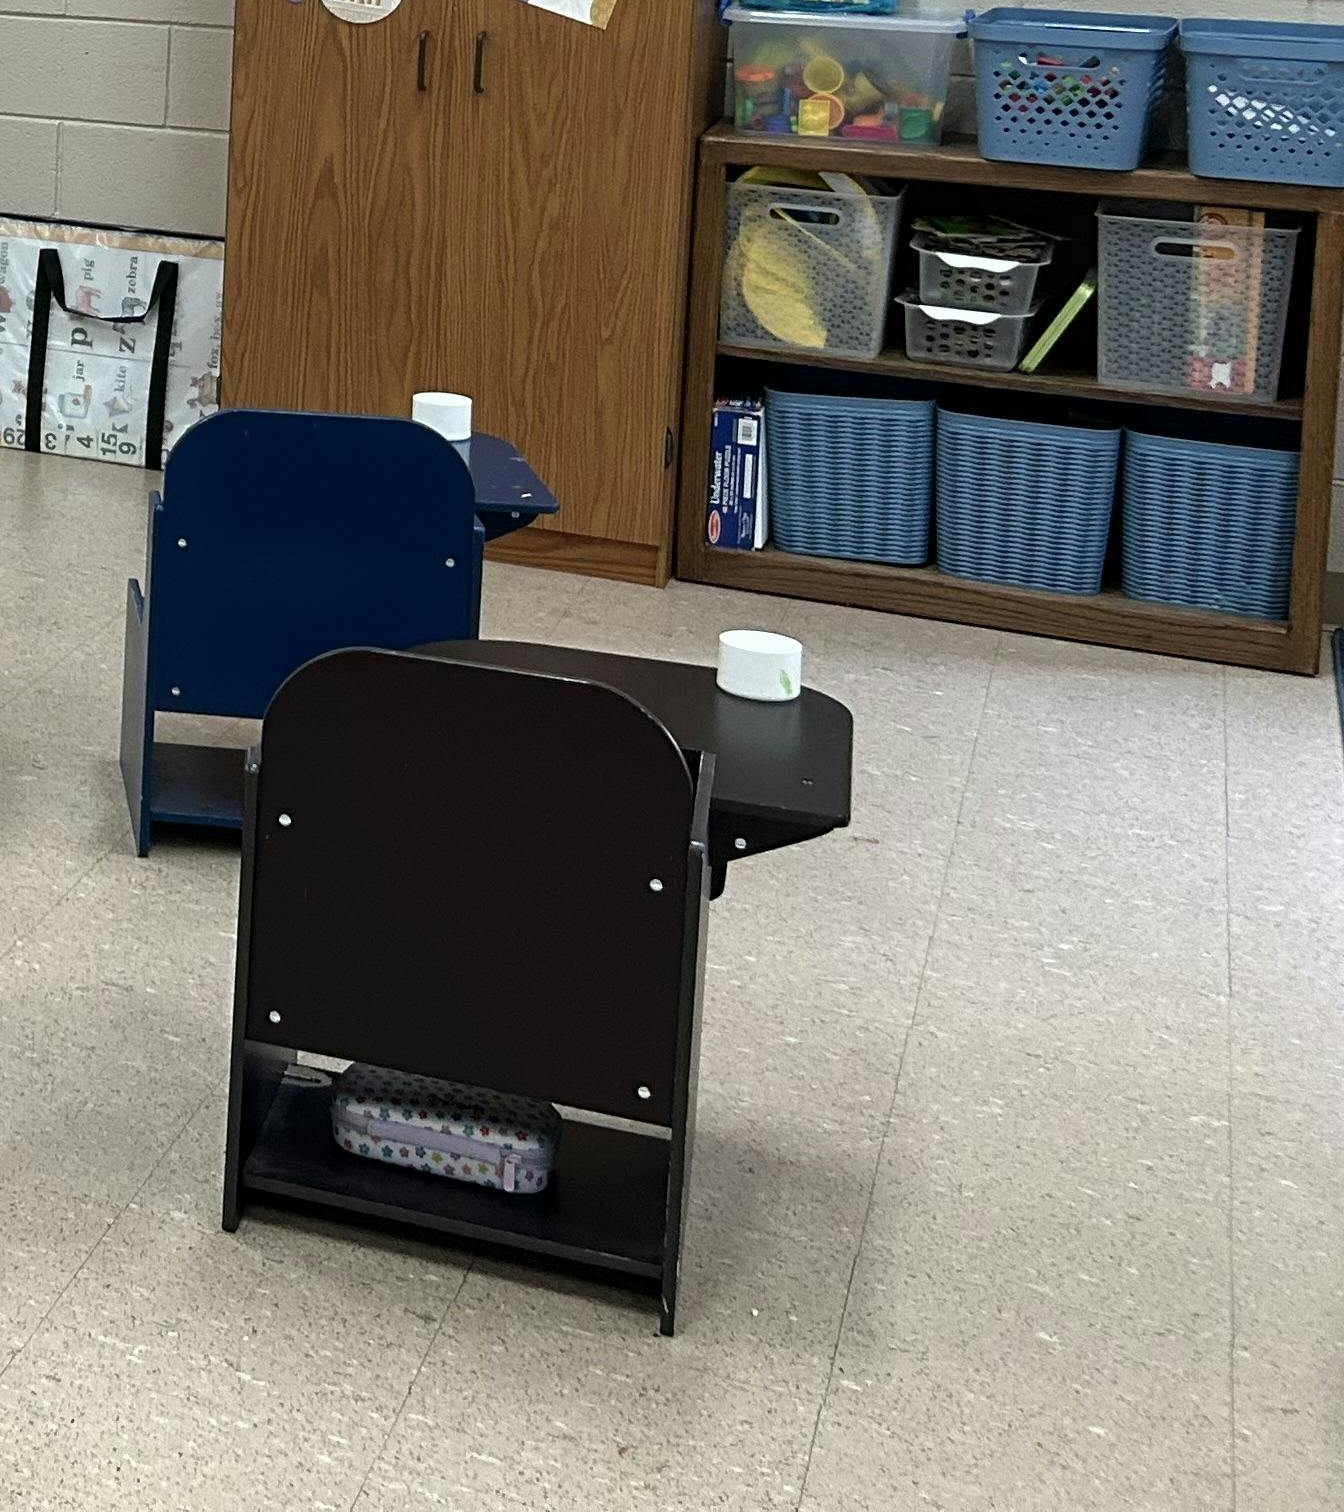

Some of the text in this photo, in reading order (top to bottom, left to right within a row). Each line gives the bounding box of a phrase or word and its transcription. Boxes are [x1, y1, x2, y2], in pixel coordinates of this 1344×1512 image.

[83, 258, 95, 281] pig
[127, 256, 138, 294] zebra
[72, 360, 85, 382] jar
[114, 365, 127, 392] kite
[45, 432, 57, 450] 3
[76, 435, 94, 448] 4
[100, 432, 118, 455] 15
[709, 450, 722, 505] Underwater
